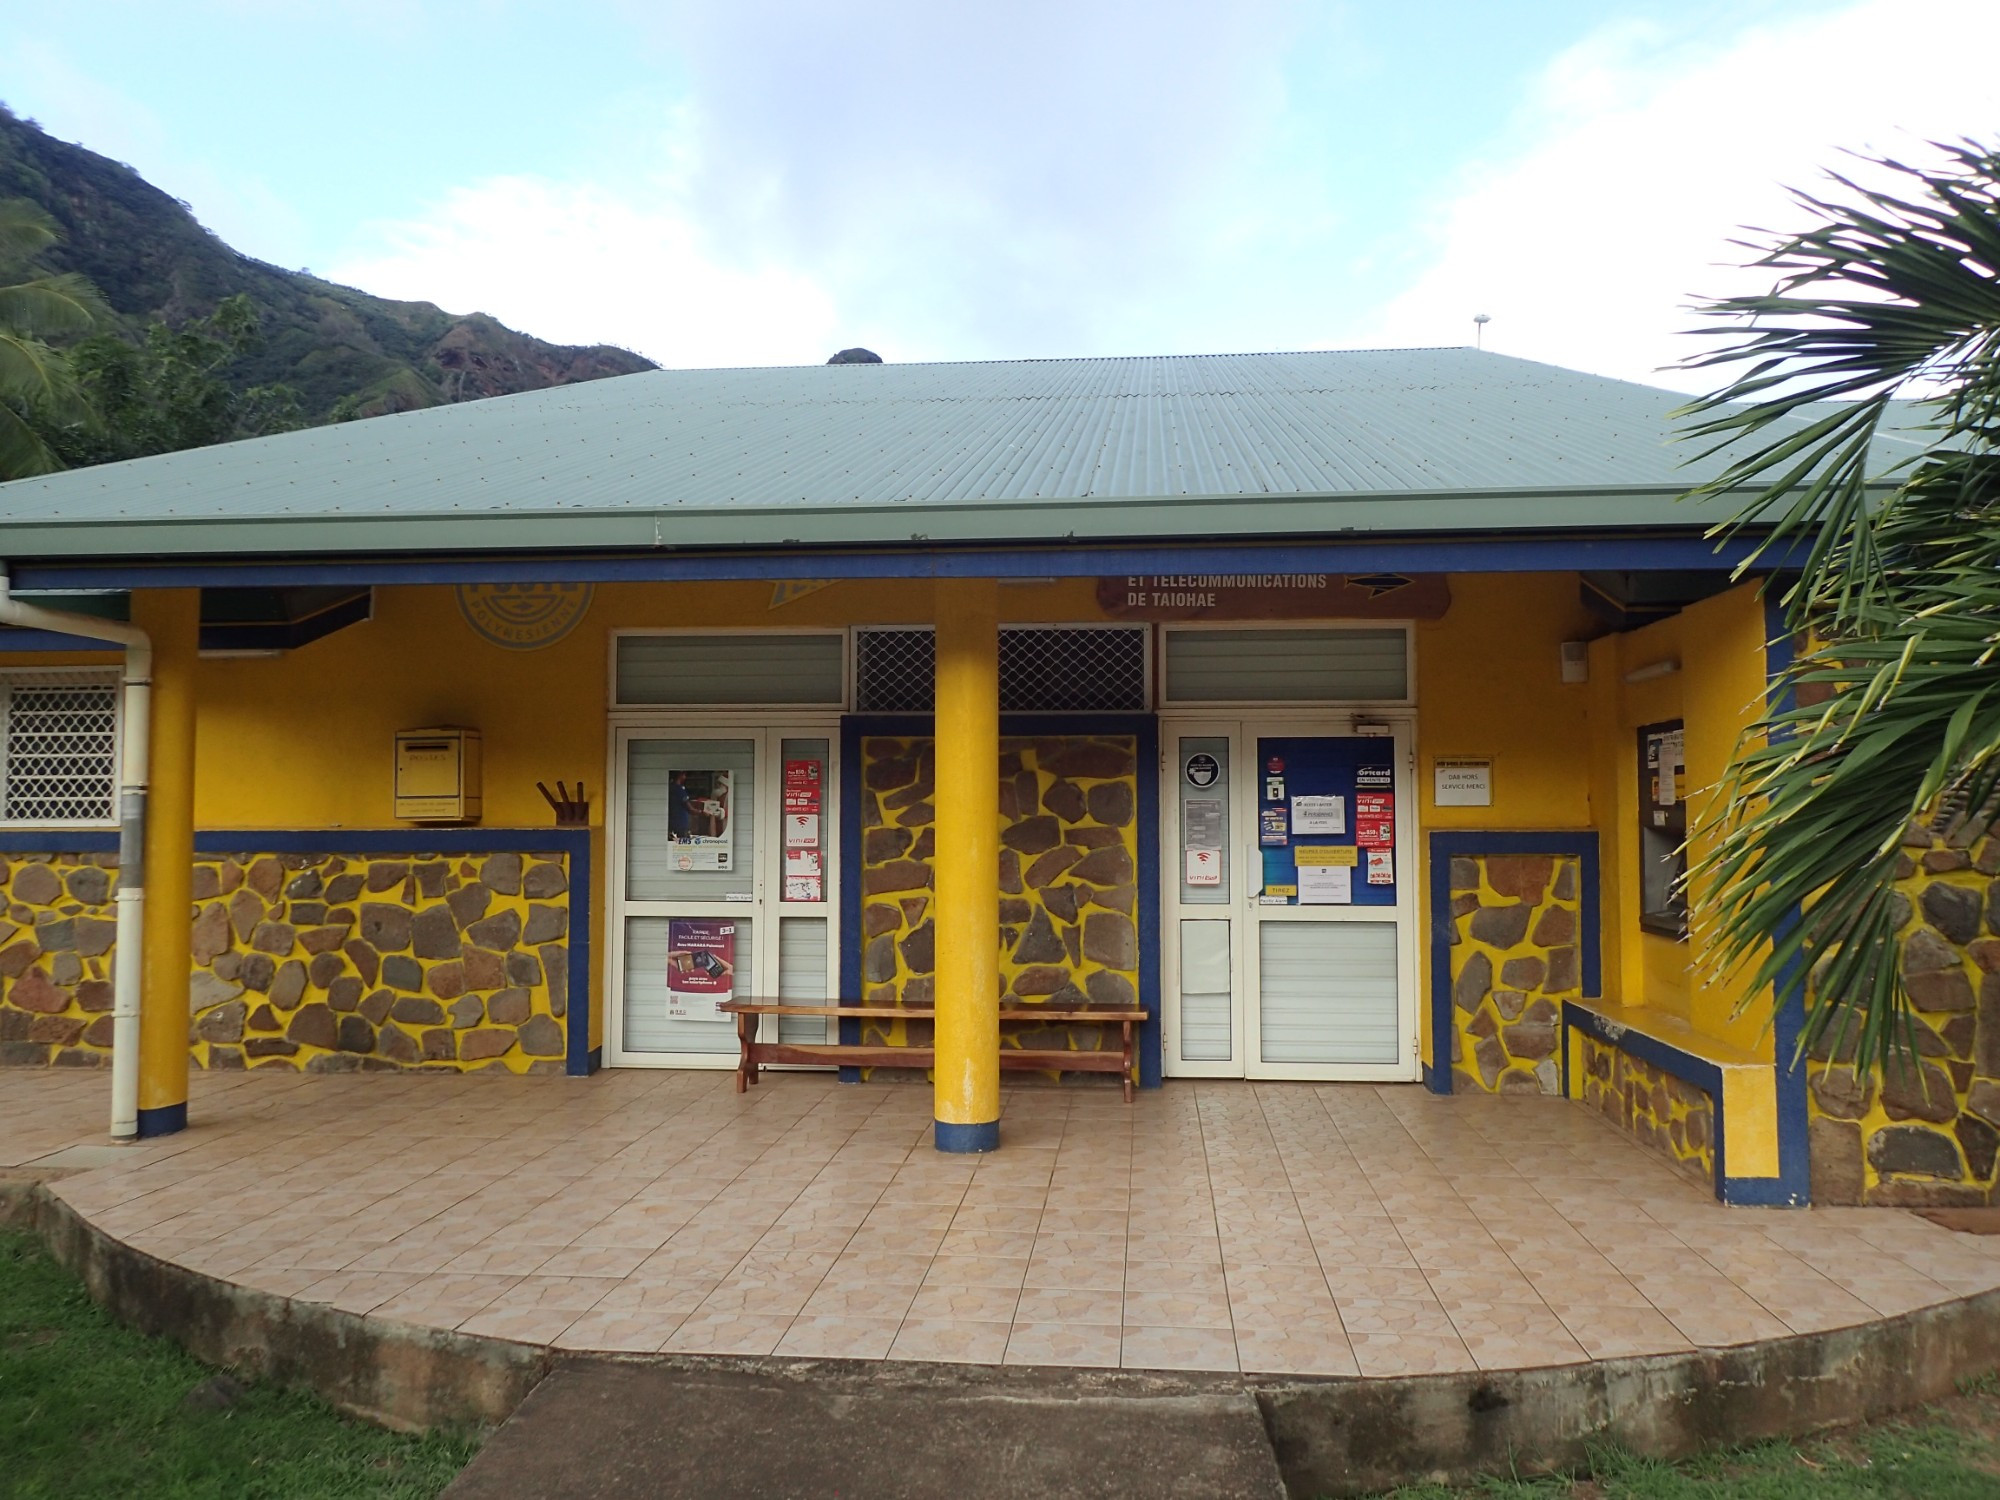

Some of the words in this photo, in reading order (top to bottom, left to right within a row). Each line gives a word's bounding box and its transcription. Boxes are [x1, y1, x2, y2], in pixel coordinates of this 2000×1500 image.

[1128, 576, 1144, 586] ET
[1128, 592, 1146, 606] DE
[1152, 592, 1216, 606] TAIOHAE
